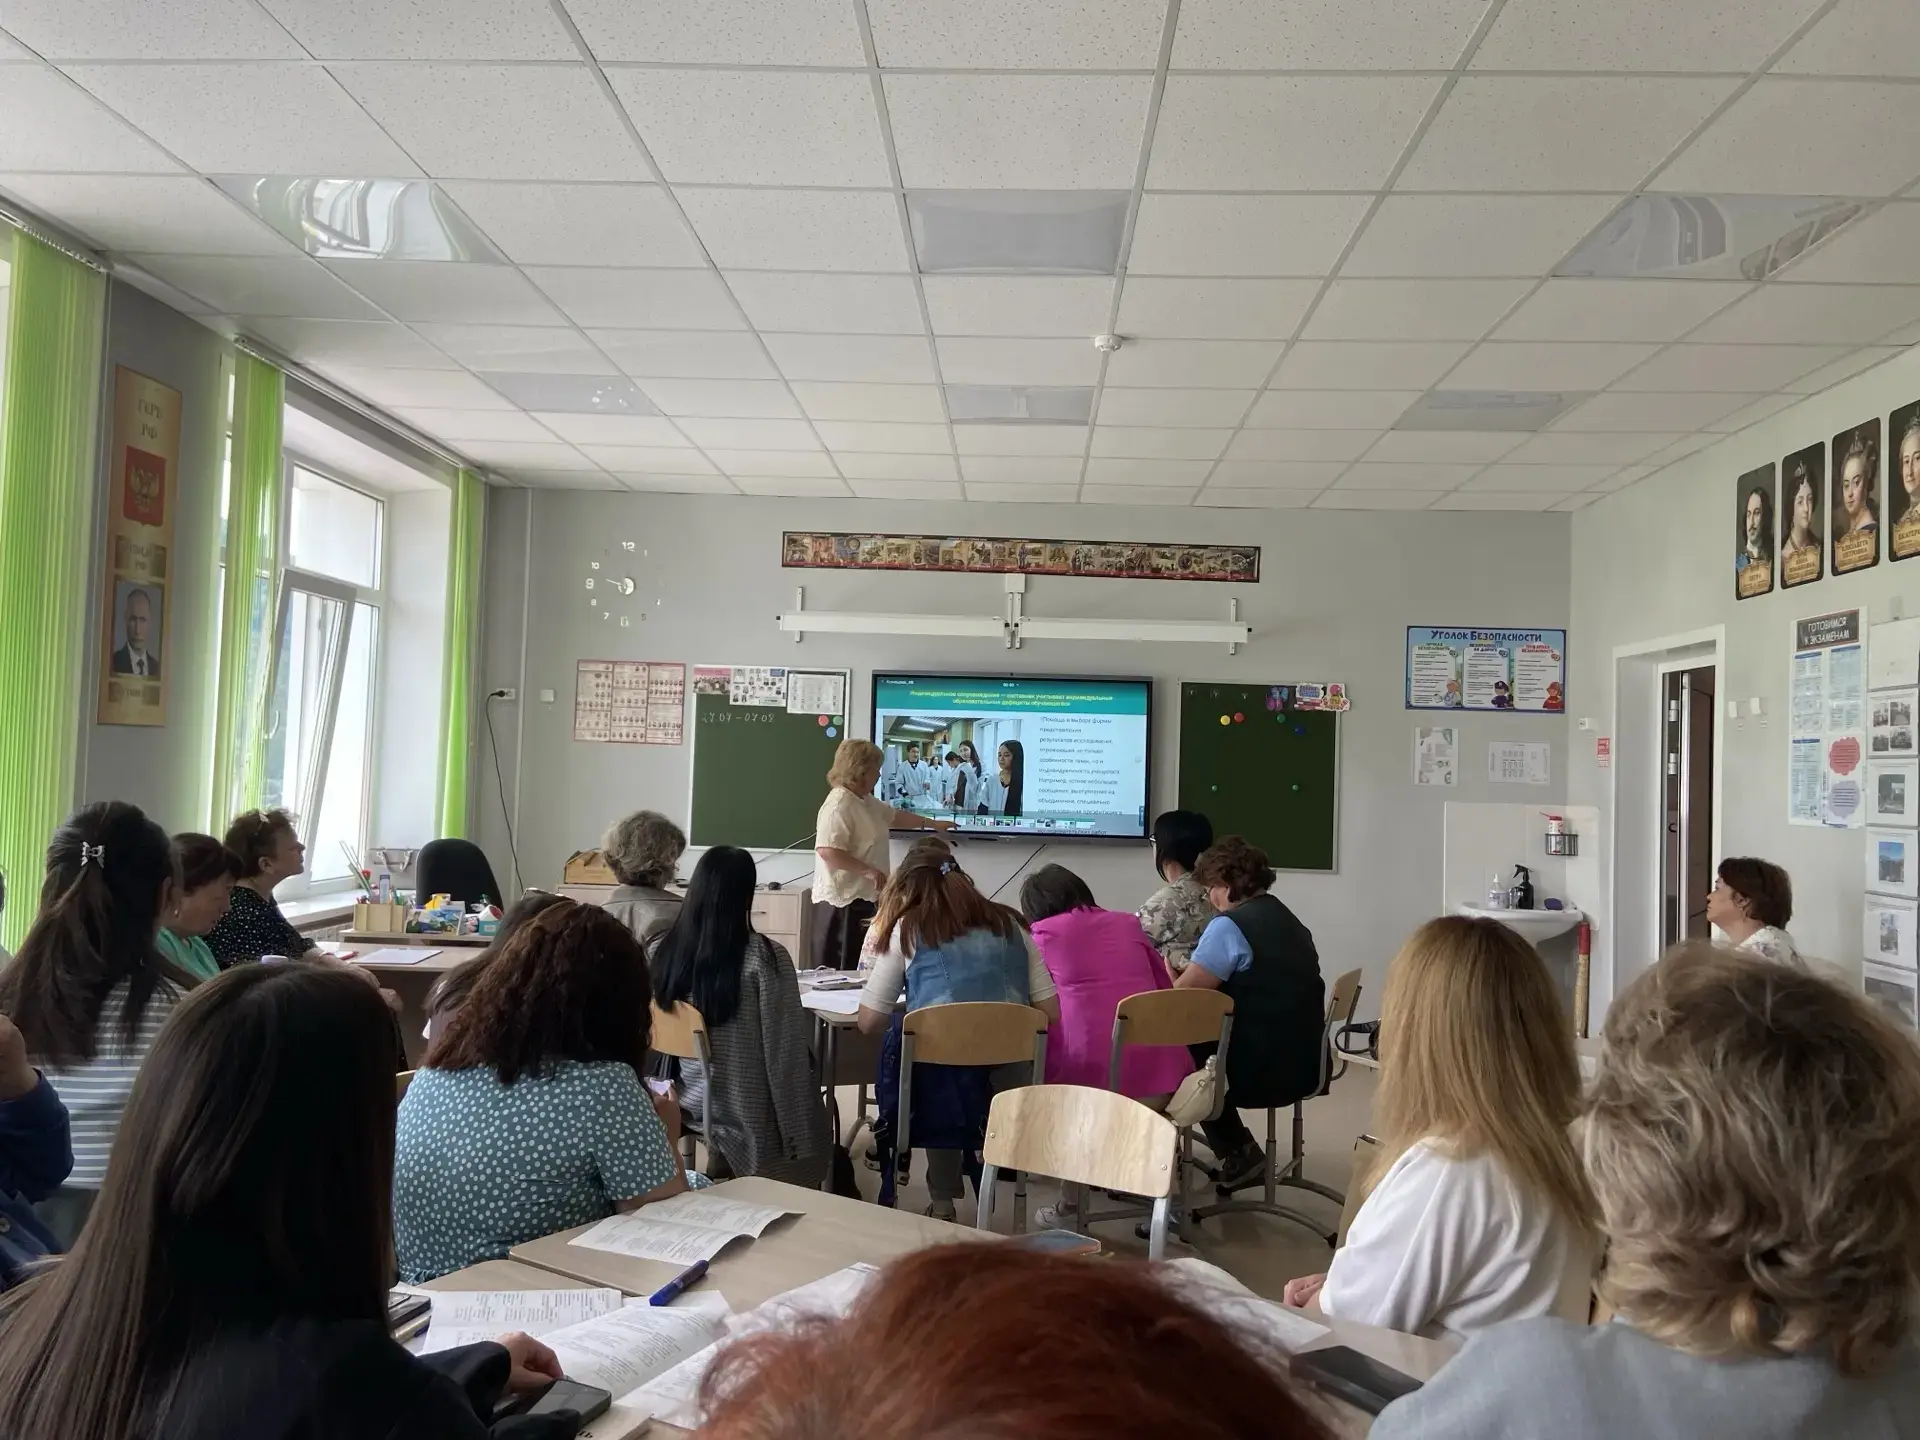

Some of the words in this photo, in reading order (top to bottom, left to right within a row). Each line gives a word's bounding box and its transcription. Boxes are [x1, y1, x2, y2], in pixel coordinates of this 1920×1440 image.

[621, 541, 636, 552] 12
[591, 561, 600, 570] 10
[603, 612, 609, 620] 7
[1808, 616, 1847, 633] ГОТОВИМСЯ
[1810, 629, 1850, 645] ЭКЗАМЕНАМ
